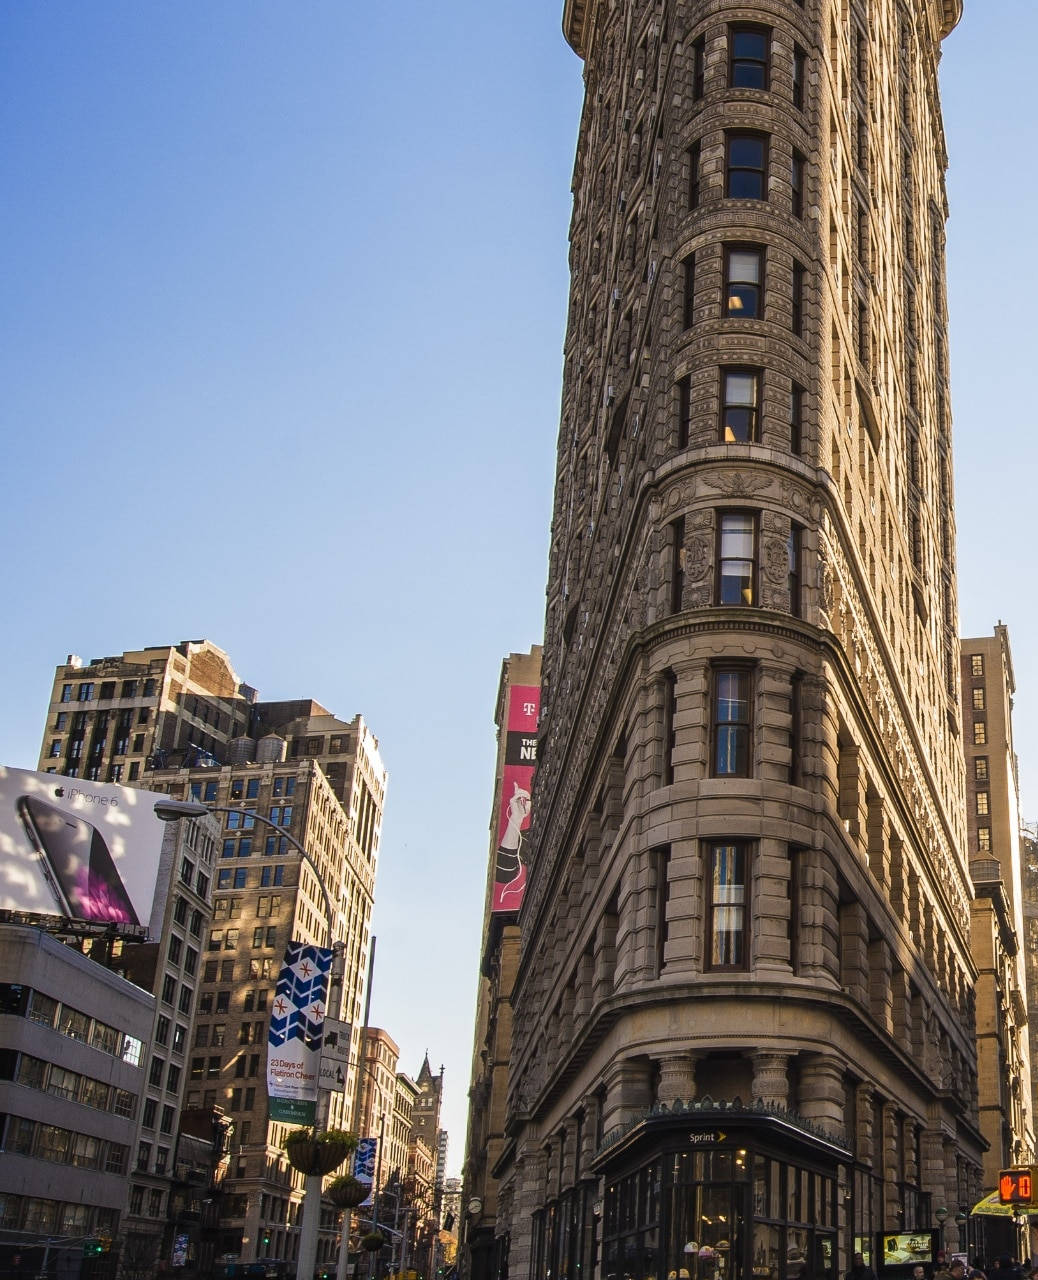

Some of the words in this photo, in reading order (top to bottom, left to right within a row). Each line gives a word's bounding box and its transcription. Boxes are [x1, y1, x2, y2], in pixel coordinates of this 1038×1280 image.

[67, 788, 109, 806] iPhone
[110, 795, 119, 807] 6
[270, 1059, 279, 1068] 23
[280, 1060, 296, 1071] Days
[296, 1061, 304, 1069] of
[270, 1069, 295, 1079] Flatiron
[295, 1071, 316, 1081] Cheer
[690, 1132, 715, 1144] Sprint
